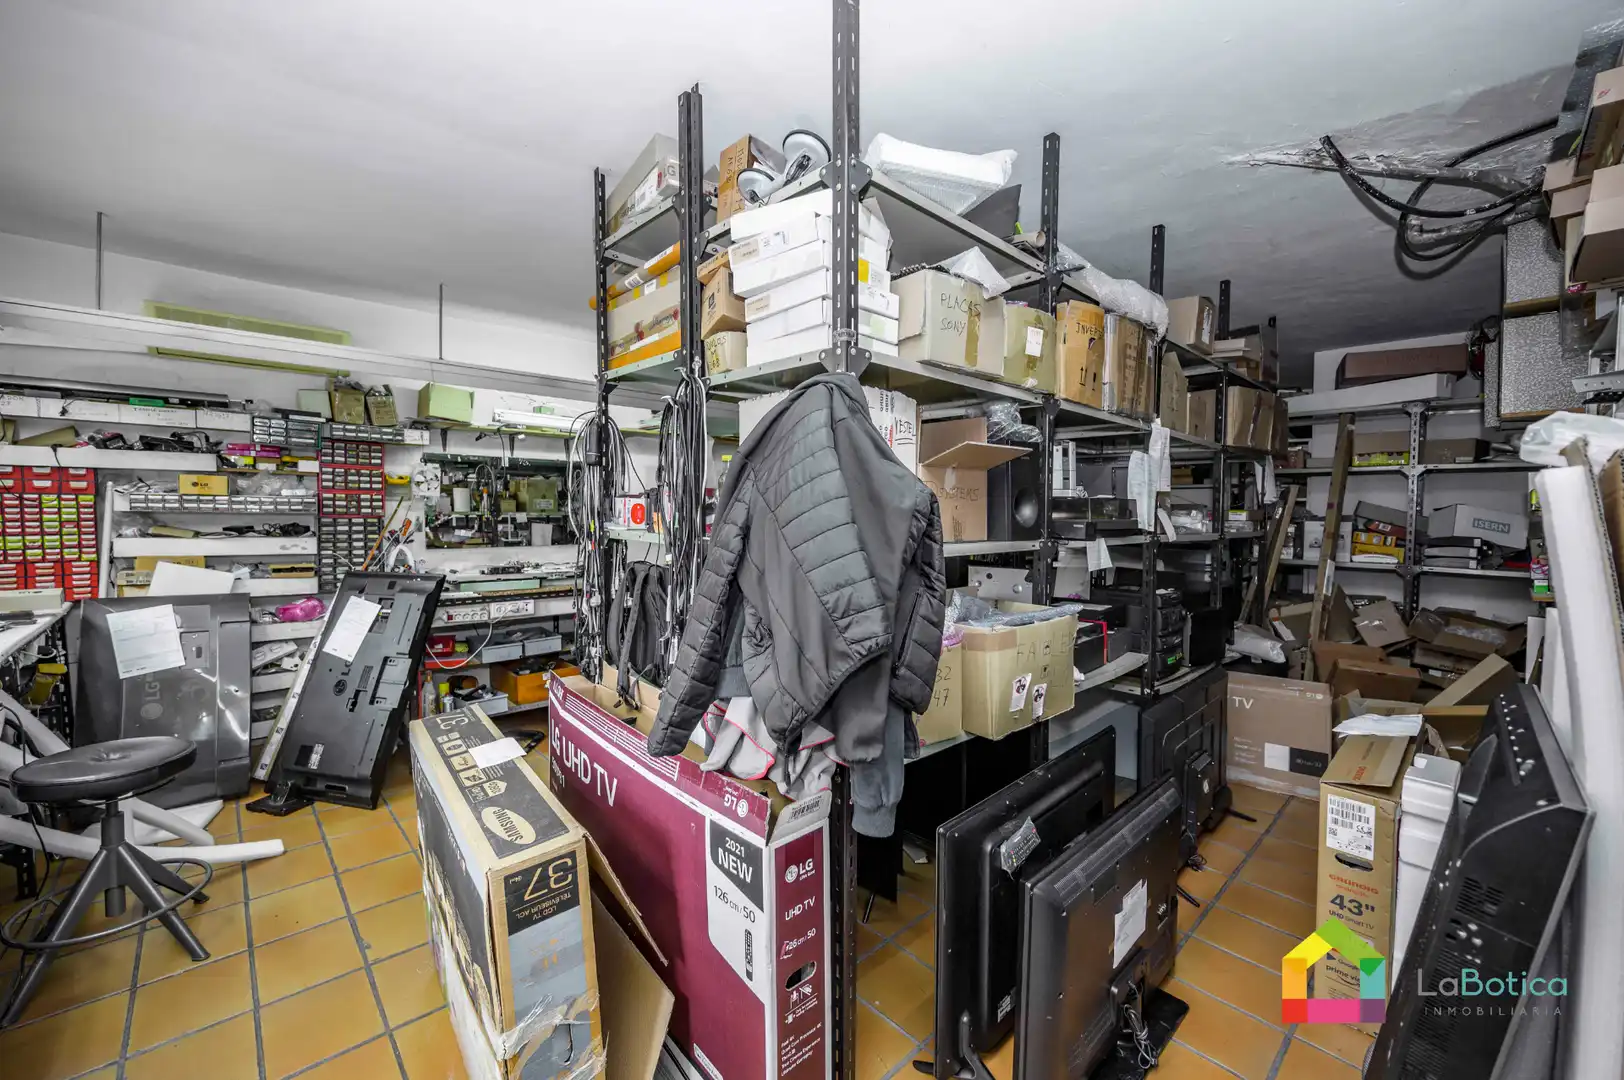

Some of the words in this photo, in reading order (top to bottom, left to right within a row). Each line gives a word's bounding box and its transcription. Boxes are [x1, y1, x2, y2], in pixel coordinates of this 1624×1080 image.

[940, 292, 982, 317] PLACAS
[940, 317, 967, 337] SONY
[1474, 519, 1510, 533] ISERN
[145, 682, 160, 701] LG
[1233, 696, 1254, 709] TV
[436, 713, 469, 730] 37
[552, 718, 561, 756] LG
[562, 735, 592, 785] UHD
[593, 761, 618, 807] TV
[724, 794, 737, 811] LG
[492, 808, 524, 842] SAMSUNG
[725, 836, 745, 858] 2021
[718, 847, 753, 883] NEW
[799, 859, 813, 875] LG
[523, 857, 573, 901] 37
[543, 905, 557, 916] LCD
[713, 885, 729, 905] 126
[743, 905, 755, 924] 50
[785, 904, 802, 921] UHD
[803, 896, 816, 910] TV
[533, 910, 542, 920] TV
[1328, 909, 1344, 920] UHD
[807, 927, 816, 940] 50
[1325, 964, 1349, 979] prime
